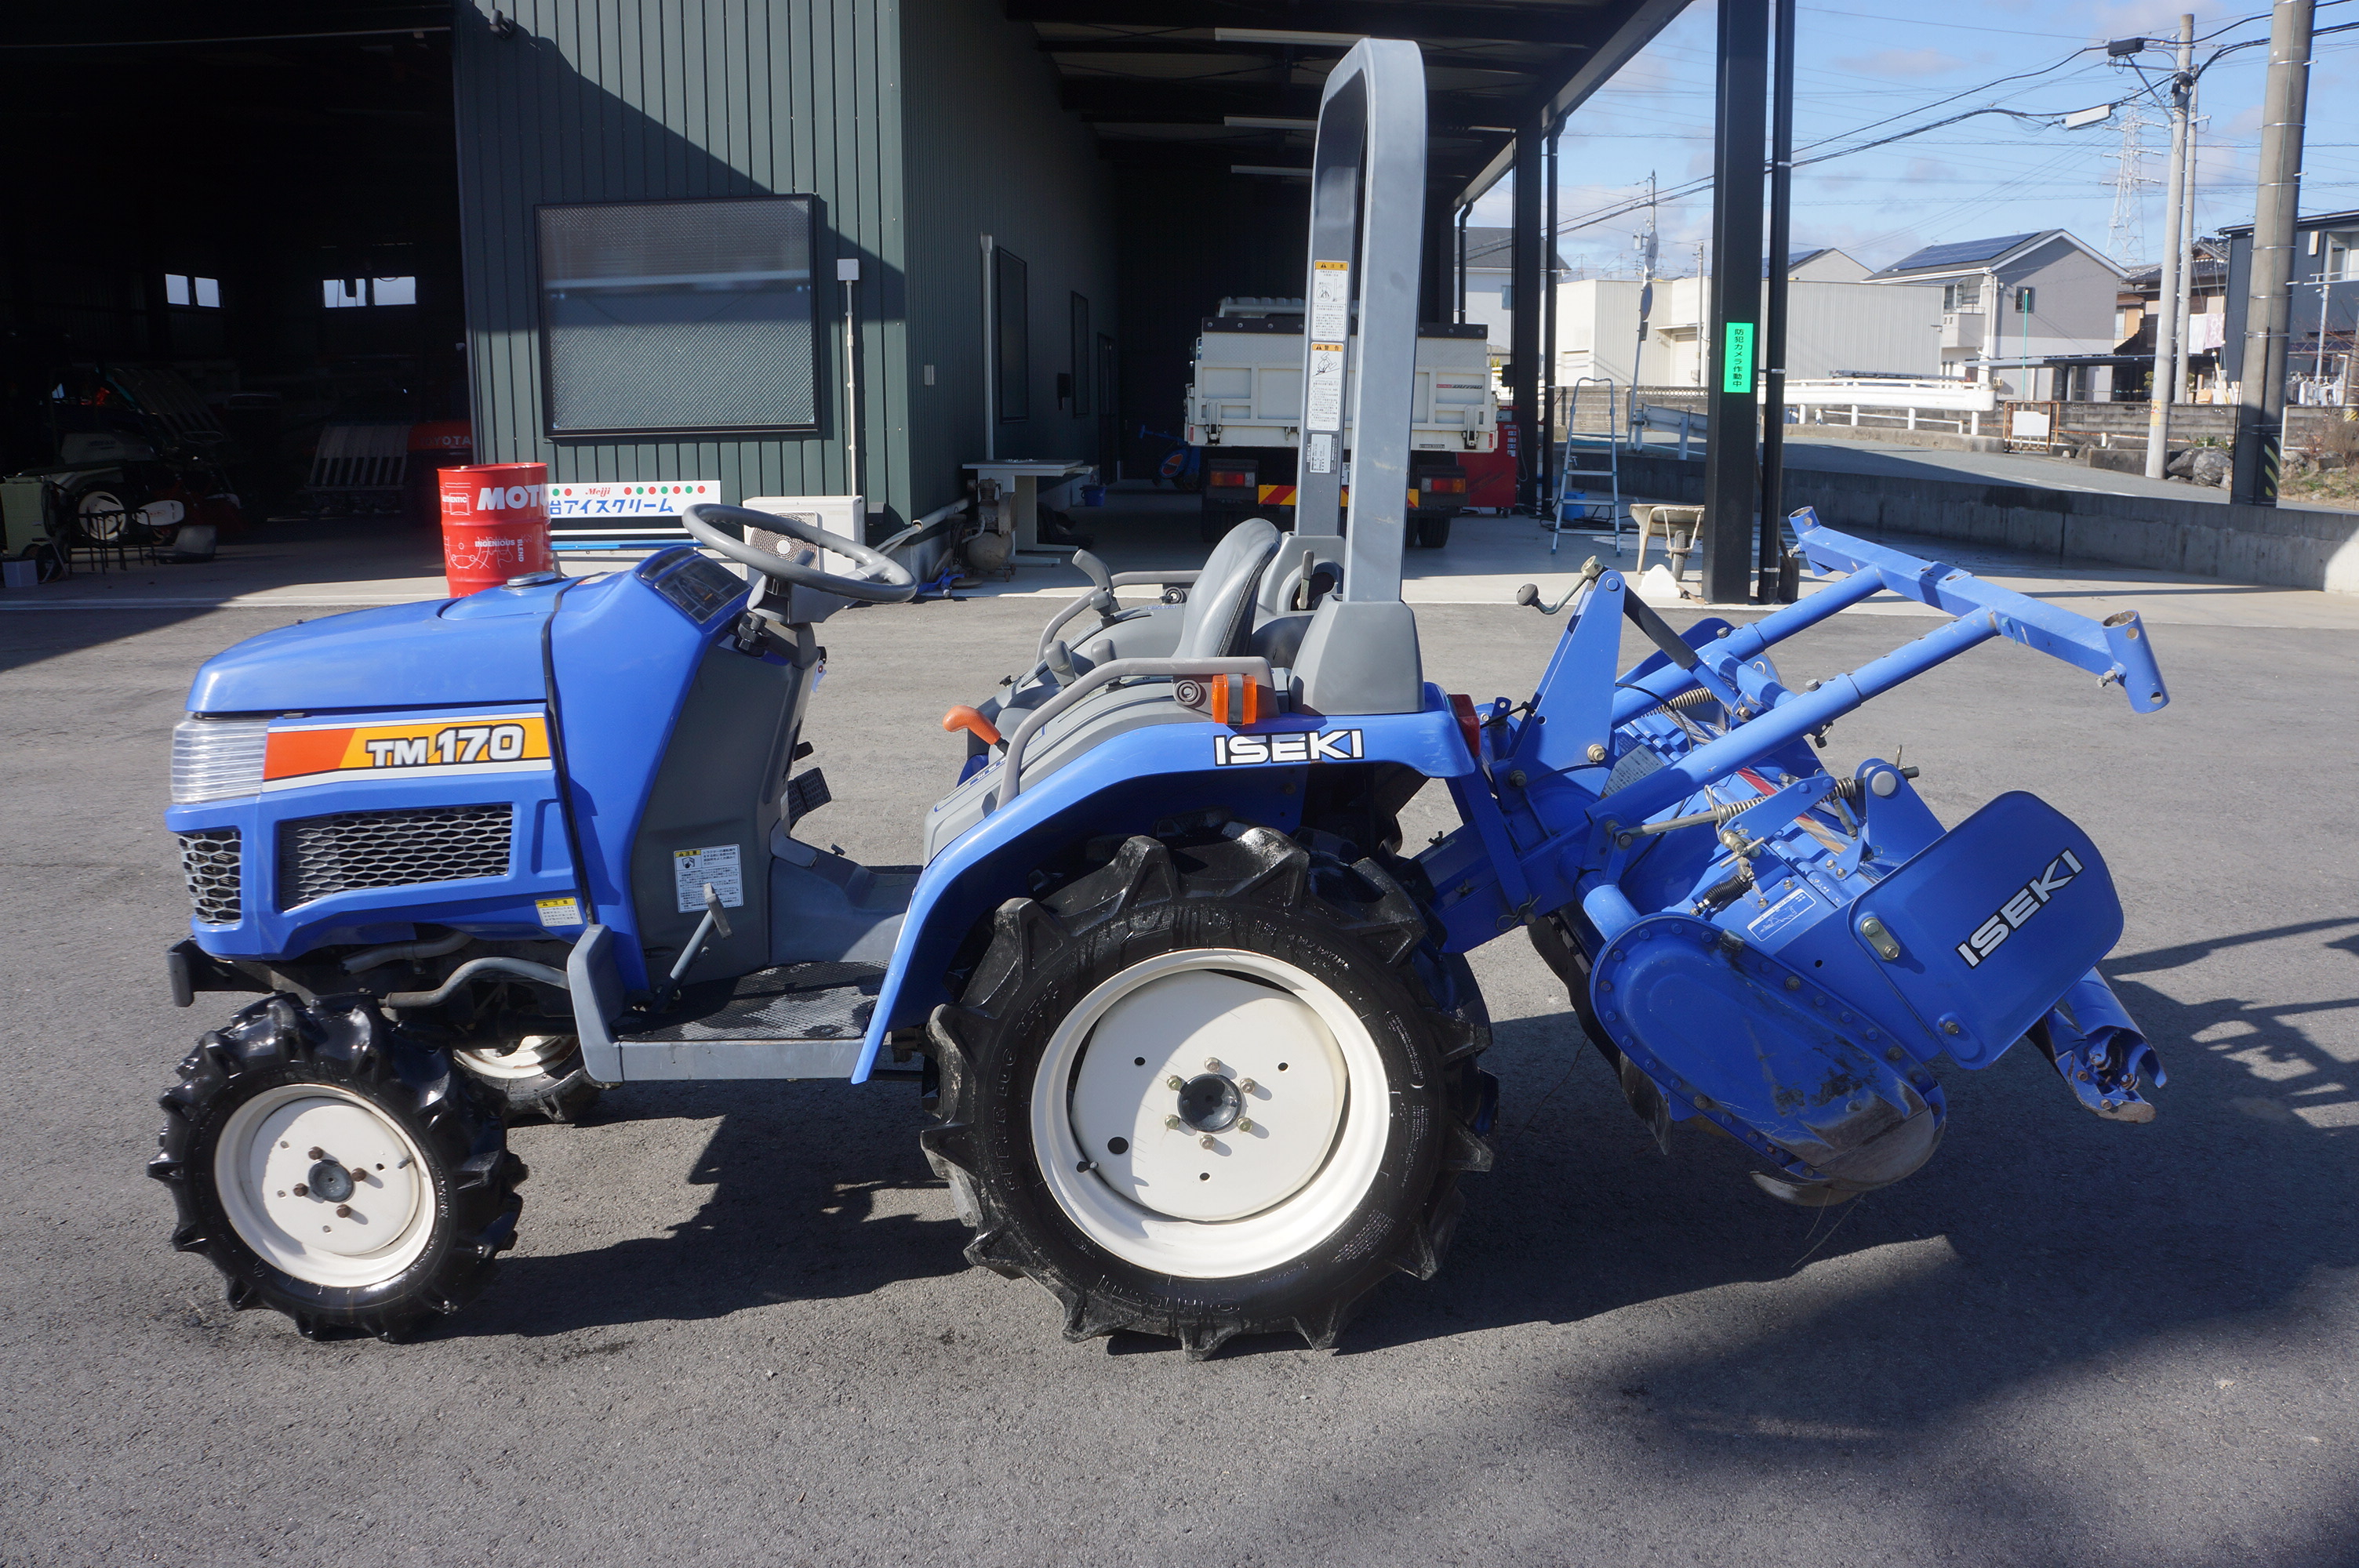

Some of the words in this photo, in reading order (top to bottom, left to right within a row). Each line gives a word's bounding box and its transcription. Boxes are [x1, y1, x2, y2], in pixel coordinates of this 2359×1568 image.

[1732, 328, 1745, 387] 防犯カメラ作動中
[419, 436, 472, 445] TOYOTA
[585, 487, 611, 497] Meiji
[1215, 729, 1364, 766] ISEKI
[1957, 849, 2083, 967] ISEKI
